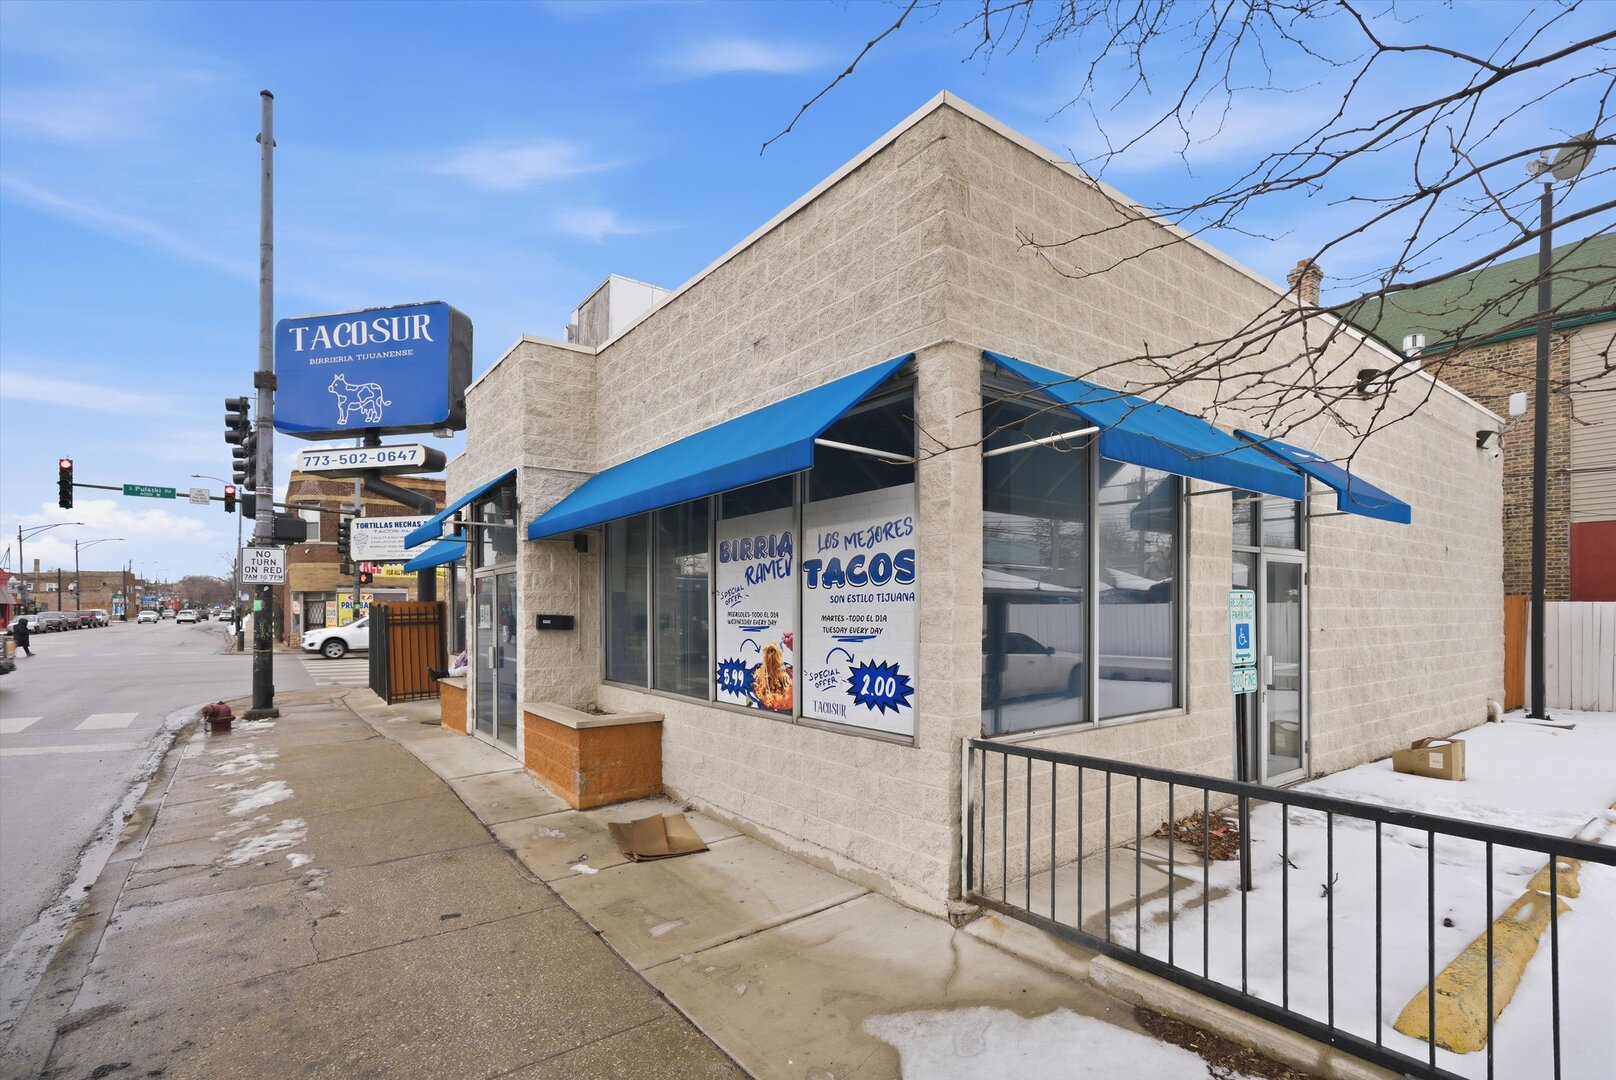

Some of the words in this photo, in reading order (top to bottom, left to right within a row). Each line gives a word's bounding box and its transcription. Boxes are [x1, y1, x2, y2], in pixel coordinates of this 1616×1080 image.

[289, 314, 433, 351] TACOSUR
[309, 355, 353, 365] BIRRIERIA
[356, 349, 413, 360] TIJUANENSE
[303, 450, 417, 467] 773-502-0647
[356, 521, 393, 529] TORTILLAS
[394, 520, 421, 528] HECHAS
[818, 532, 839, 553] LOS
[844, 516, 913, 551] MEJORES
[720, 532, 792, 563] BIRRIA
[802, 549, 915, 589] TACOS
[720, 585, 744, 600] SPECIAL
[725, 593, 743, 605] OFFER
[830, 595, 844, 603] SON
[847, 593, 873, 603] ESTILO
[876, 592, 915, 602] TIJUANA
[1230, 598, 1253, 607] RESERVED
[1232, 610, 1252, 619] PARKING
[822, 626, 847, 634] TUESDAY
[849, 626, 868, 634] EVERY
[870, 627, 883, 635] DAY
[724, 668, 744, 687] 5.99
[809, 668, 840, 681] SPECIAL
[815, 677, 838, 688] OFFER
[860, 674, 896, 698] 2.00
[813, 700, 847, 718] TACOSUR
